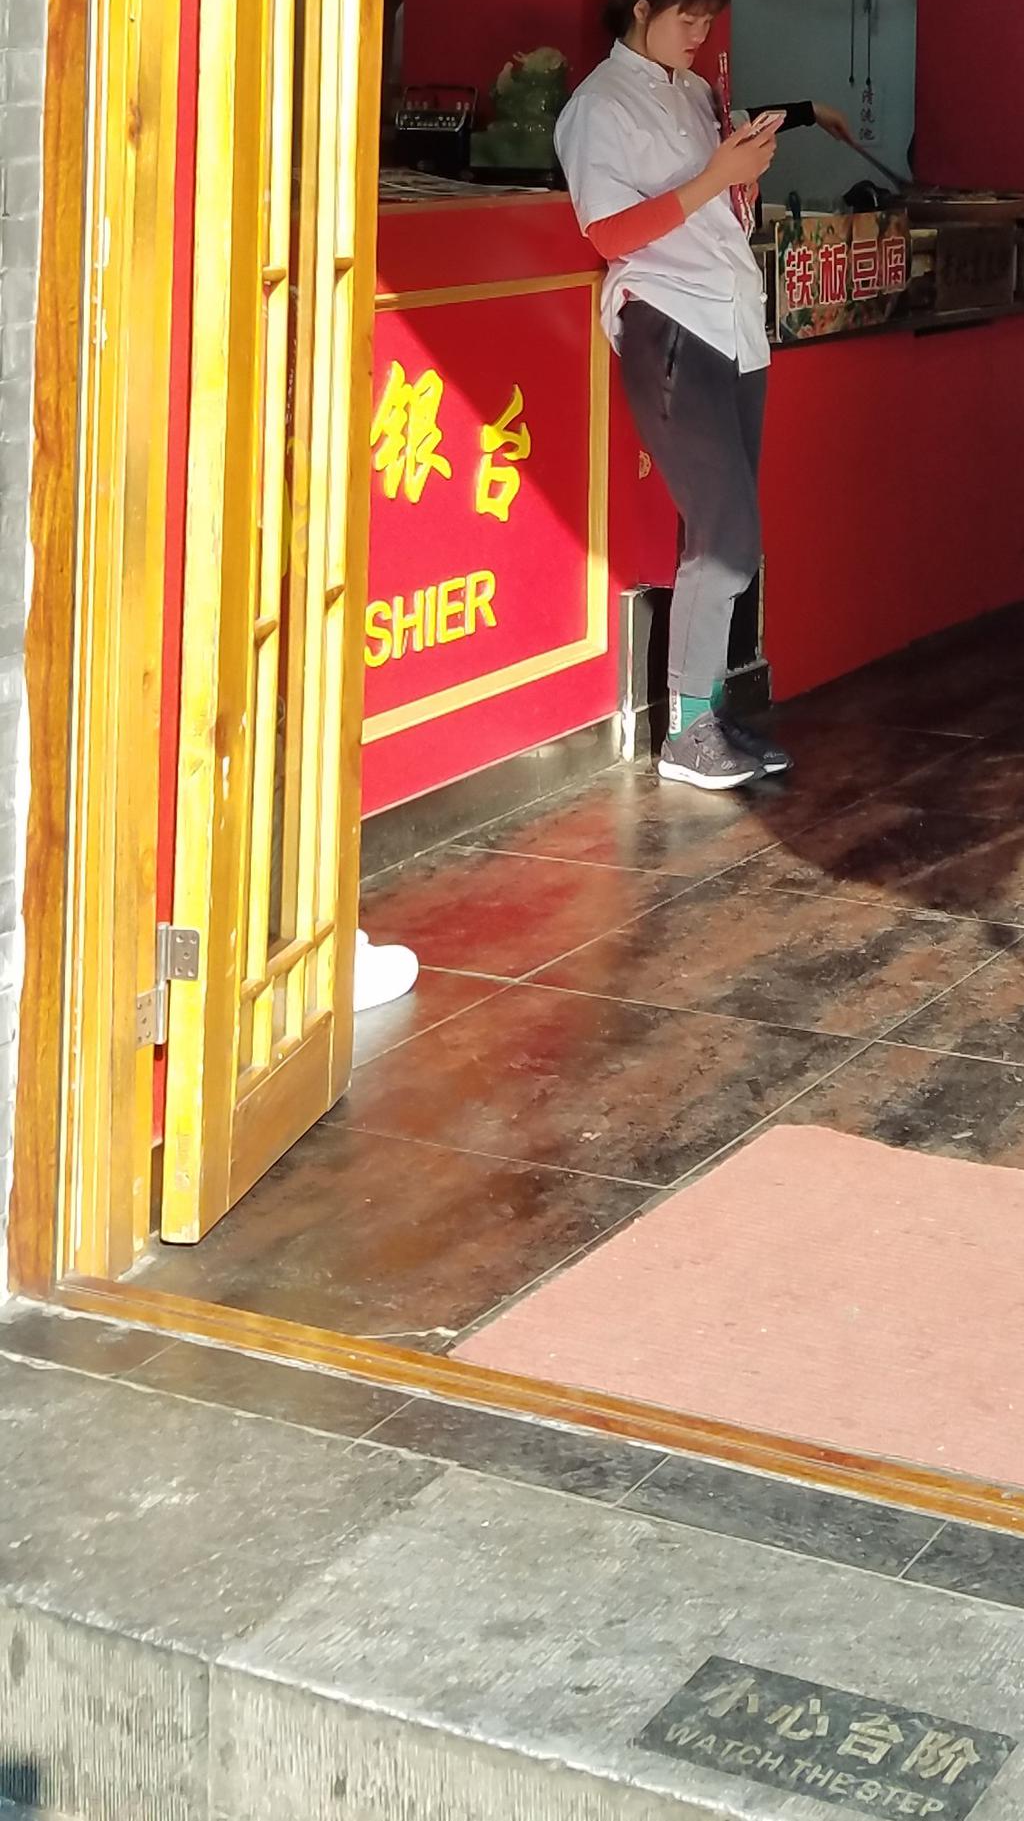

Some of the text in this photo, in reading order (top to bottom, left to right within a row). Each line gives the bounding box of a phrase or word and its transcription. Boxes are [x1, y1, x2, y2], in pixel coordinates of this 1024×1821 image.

[785, 236, 907, 310] 铁板豆腐
[364, 570, 497, 668] SHIER
[664, 1723, 946, 1817] WATCH THE STEP
[701, 1677, 981, 1785] 小心台阶
